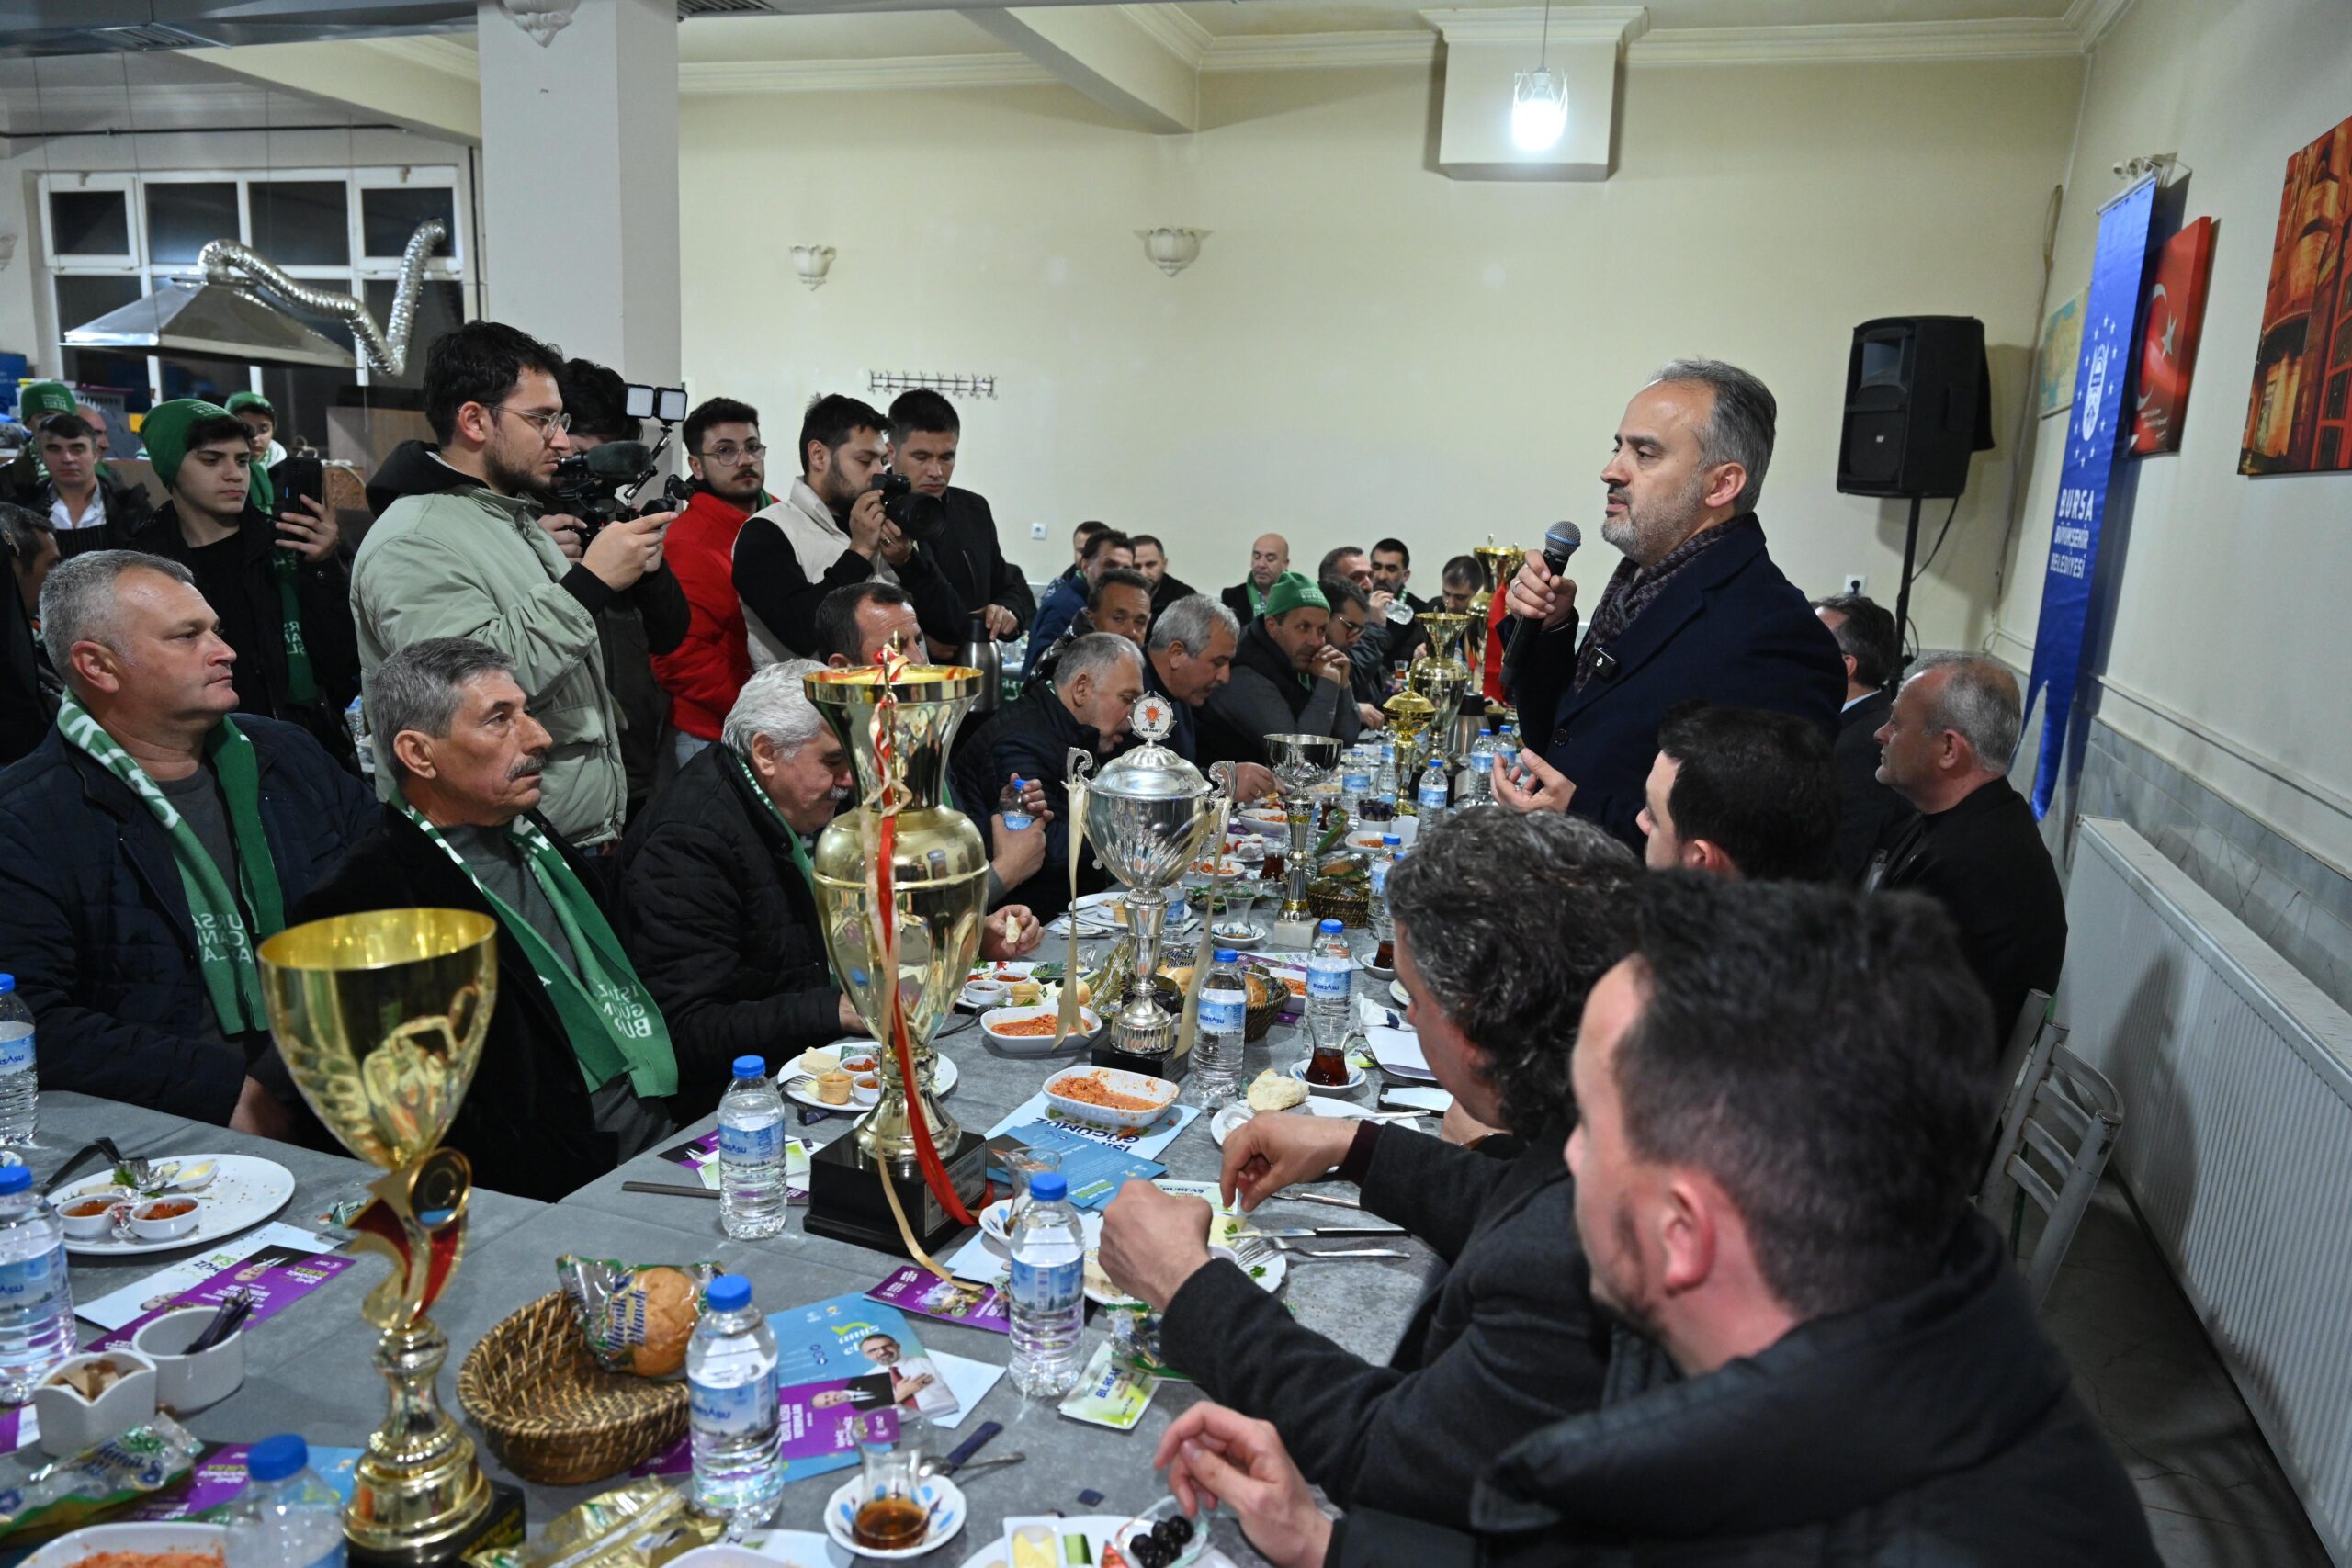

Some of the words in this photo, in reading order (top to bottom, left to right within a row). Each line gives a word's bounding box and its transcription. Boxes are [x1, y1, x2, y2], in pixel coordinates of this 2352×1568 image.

[2058, 488, 2095, 521] BURSA
[2053, 521, 2090, 554] BÜYÜKŞEHİR
[2050, 552, 2086, 579] BELEDİYESİ
[1313, 983, 1340, 991] BURSASU
[1199, 1013, 1225, 1024] BURSASU
